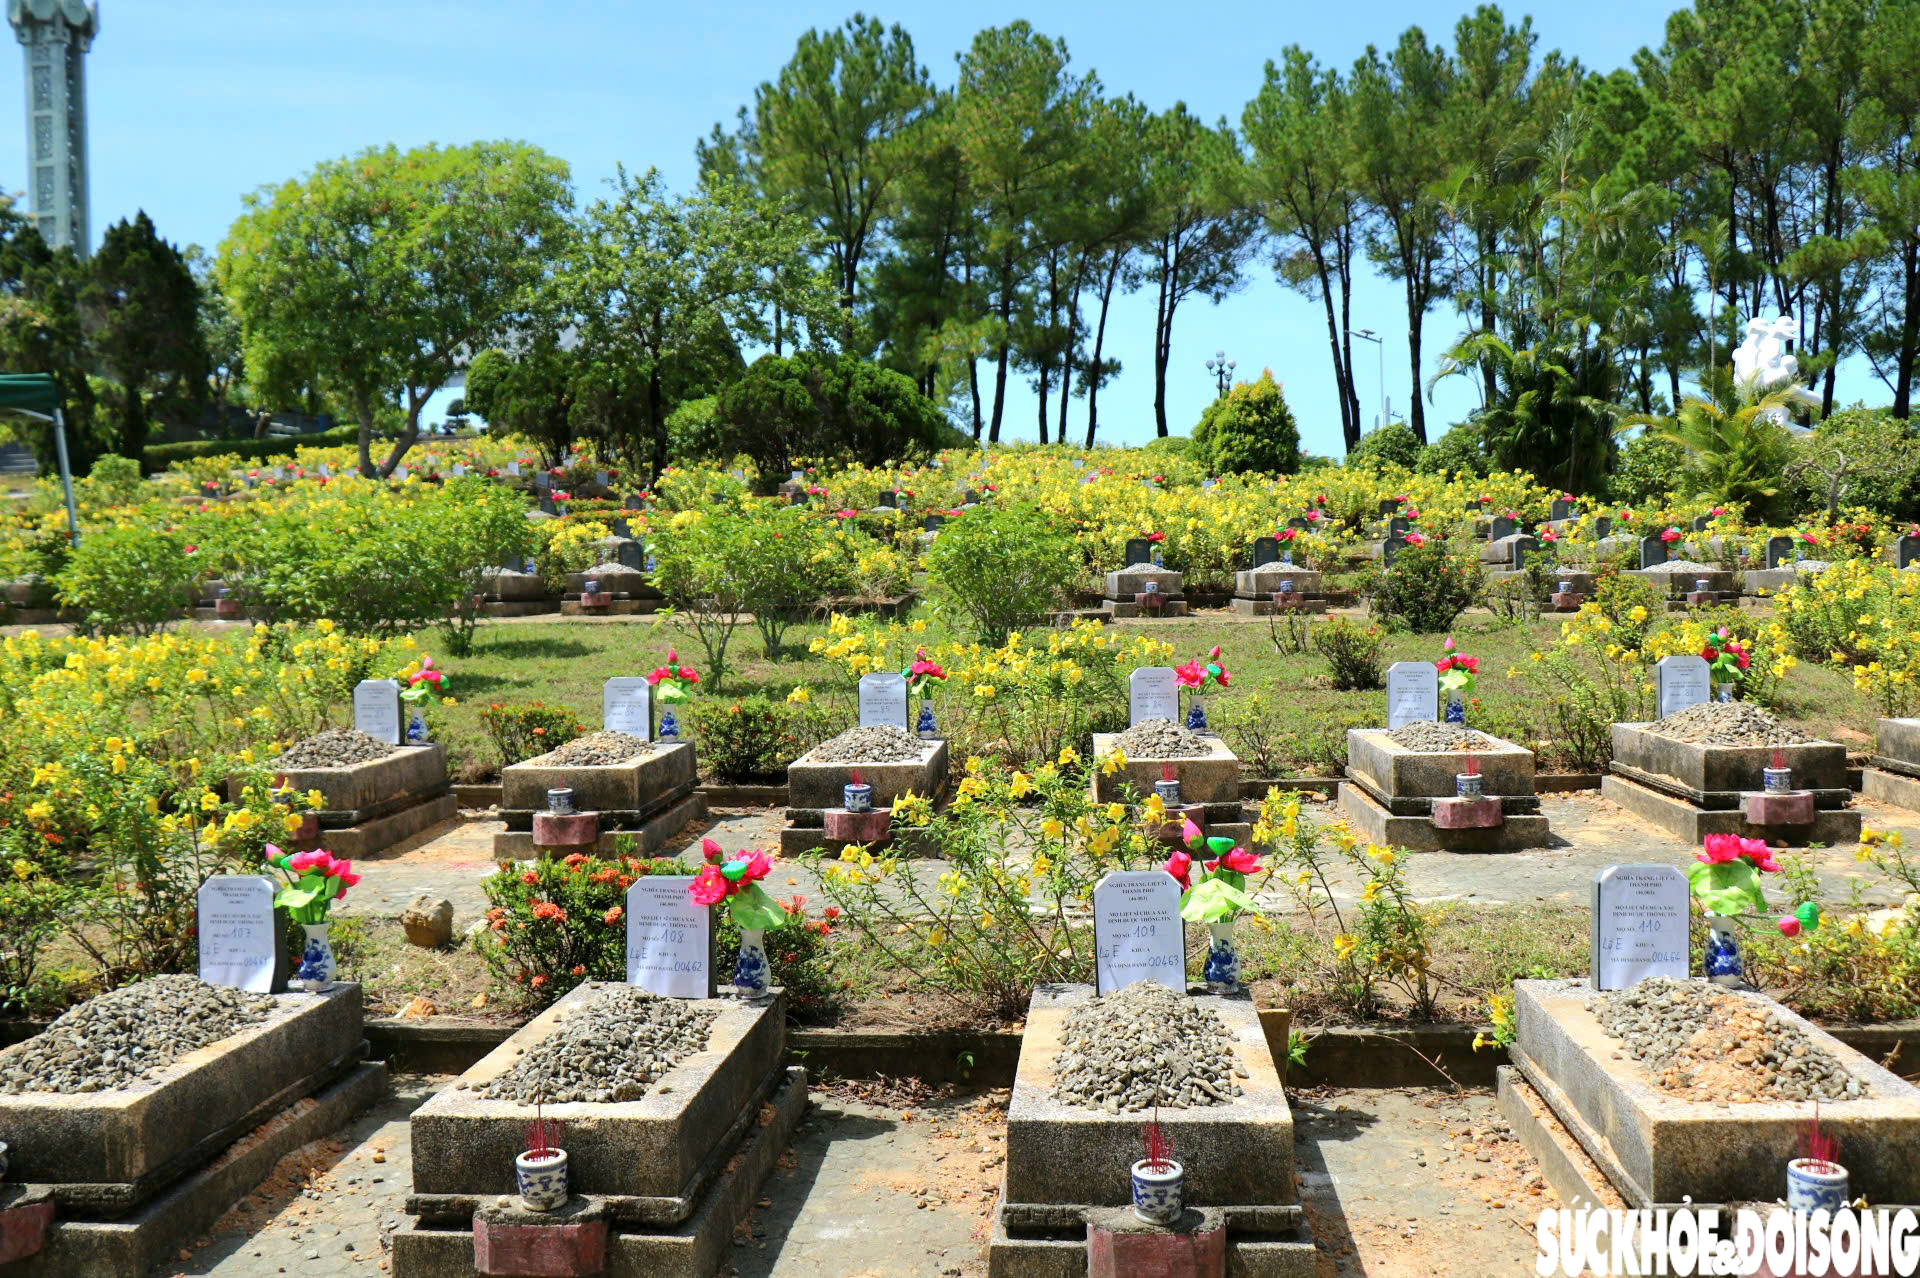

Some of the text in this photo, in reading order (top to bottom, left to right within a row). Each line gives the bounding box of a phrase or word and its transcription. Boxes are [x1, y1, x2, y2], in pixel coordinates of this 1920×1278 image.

[660, 929, 684, 944] 108
[1133, 924, 1156, 938] 109
[674, 960, 702, 972] 00462
